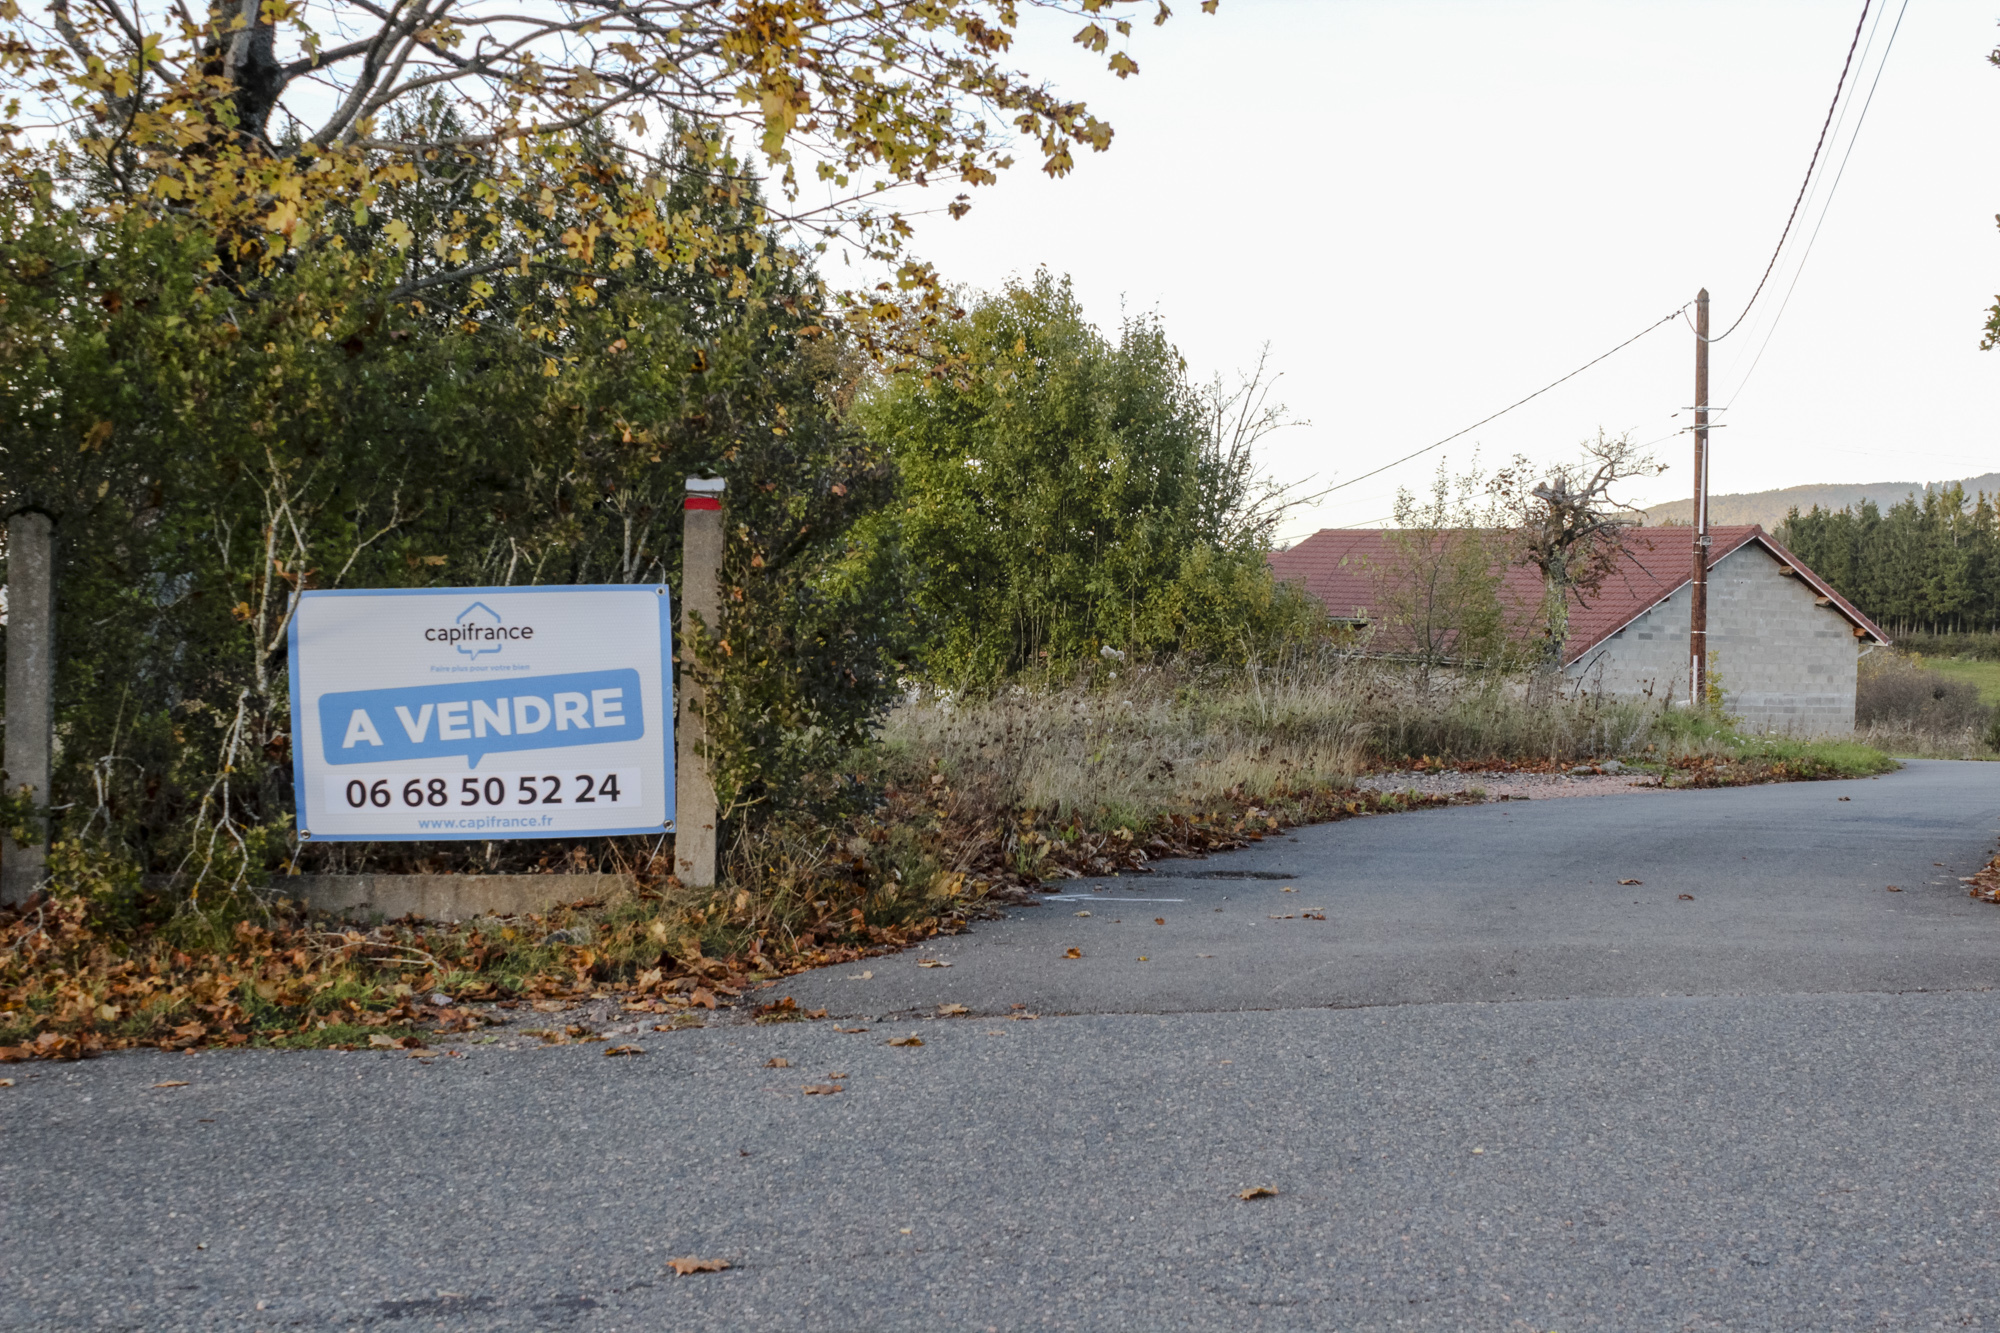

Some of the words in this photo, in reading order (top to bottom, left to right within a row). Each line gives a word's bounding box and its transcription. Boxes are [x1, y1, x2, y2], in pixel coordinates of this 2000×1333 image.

[425, 622, 534, 646] capifrance
[430, 665, 450, 673] Faire
[451, 665, 469, 673] plus
[470, 665, 489, 673] pour
[341, 708, 384, 749] A
[395, 687, 626, 744] VENDRE
[345, 778, 391, 808] 06
[403, 777, 448, 807] 68
[460, 776, 505, 807] 50
[517, 775, 562, 805] 52
[574, 773, 621, 804] 24
[418, 814, 553, 831] www.capifrance.fr
